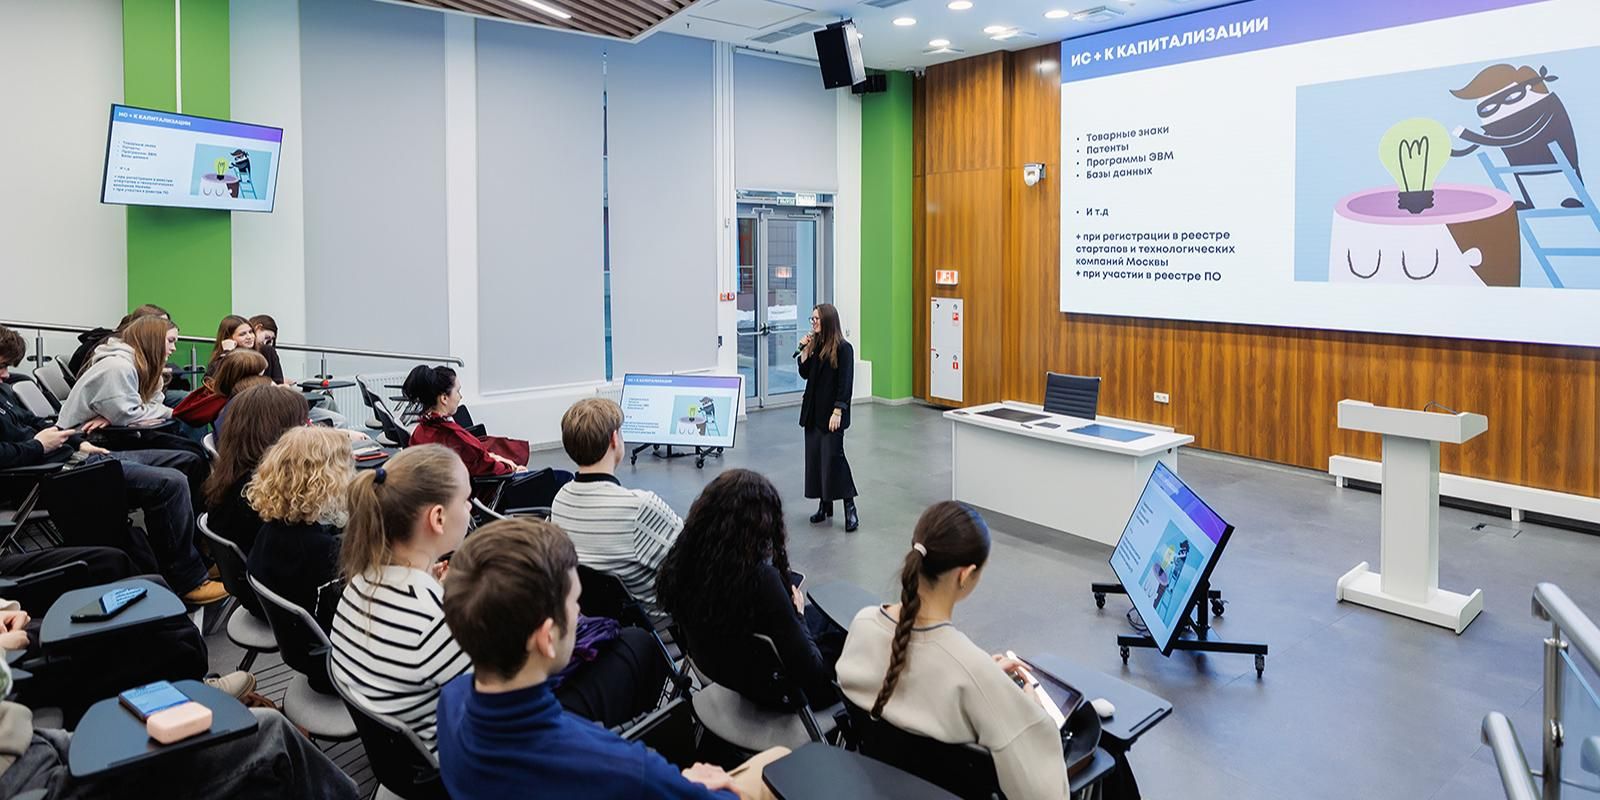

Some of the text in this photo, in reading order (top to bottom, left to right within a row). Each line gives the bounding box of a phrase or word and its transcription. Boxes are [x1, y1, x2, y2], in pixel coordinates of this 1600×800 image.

[1071, 16, 1269, 67] ИС + К КАПИТАЛИЗАЦИИ
[1086, 126, 1169, 142] Товарные знаки
[1086, 144, 1129, 154] Патенты
[1086, 151, 1174, 168] Программы ЭВМ
[1086, 167, 1153, 179] Базы данных
[1086, 208, 1093, 216] И
[1083, 232, 1100, 242] при
[1102, 231, 1170, 242] регистрации
[1172, 232, 1178, 240] в
[1181, 231, 1231, 242] реестре
[1075, 245, 1236, 255] стартапов и технологических
[1075, 256, 1169, 267] компаний Москвы
[1083, 269, 1100, 280] при
[1102, 270, 1144, 280] участии
[1146, 271, 1151, 279] в
[1154, 271, 1201, 282] реестре
[1204, 271, 1222, 281] ПО
